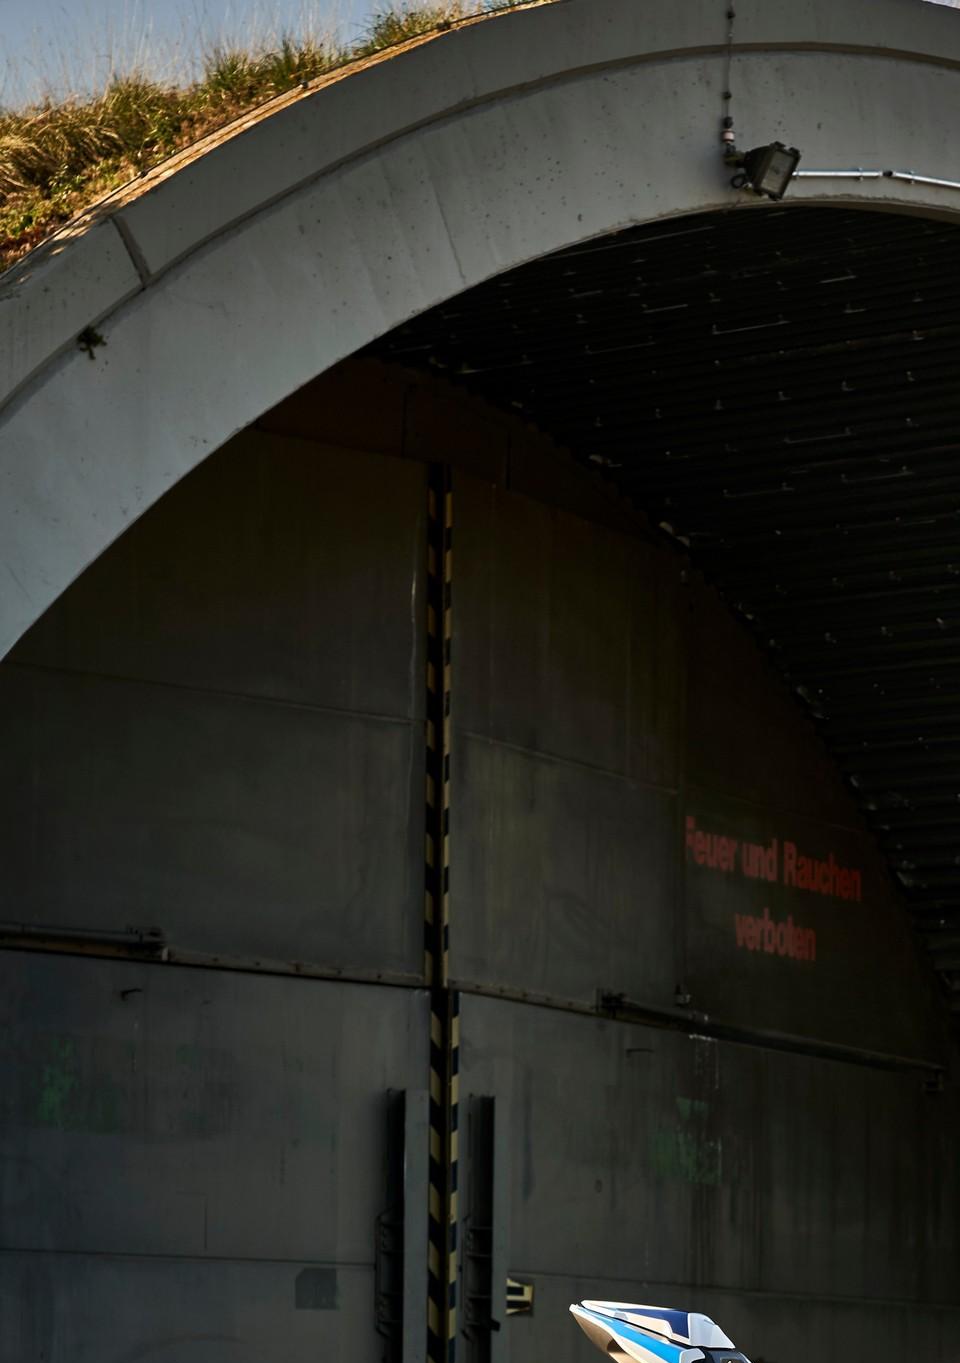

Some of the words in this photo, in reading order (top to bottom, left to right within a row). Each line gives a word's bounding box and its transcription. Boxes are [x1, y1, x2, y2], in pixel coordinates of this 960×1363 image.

[741, 838, 778, 882] und
[783, 840, 862, 902] Rauchen
[735, 907, 817, 961] verboten
